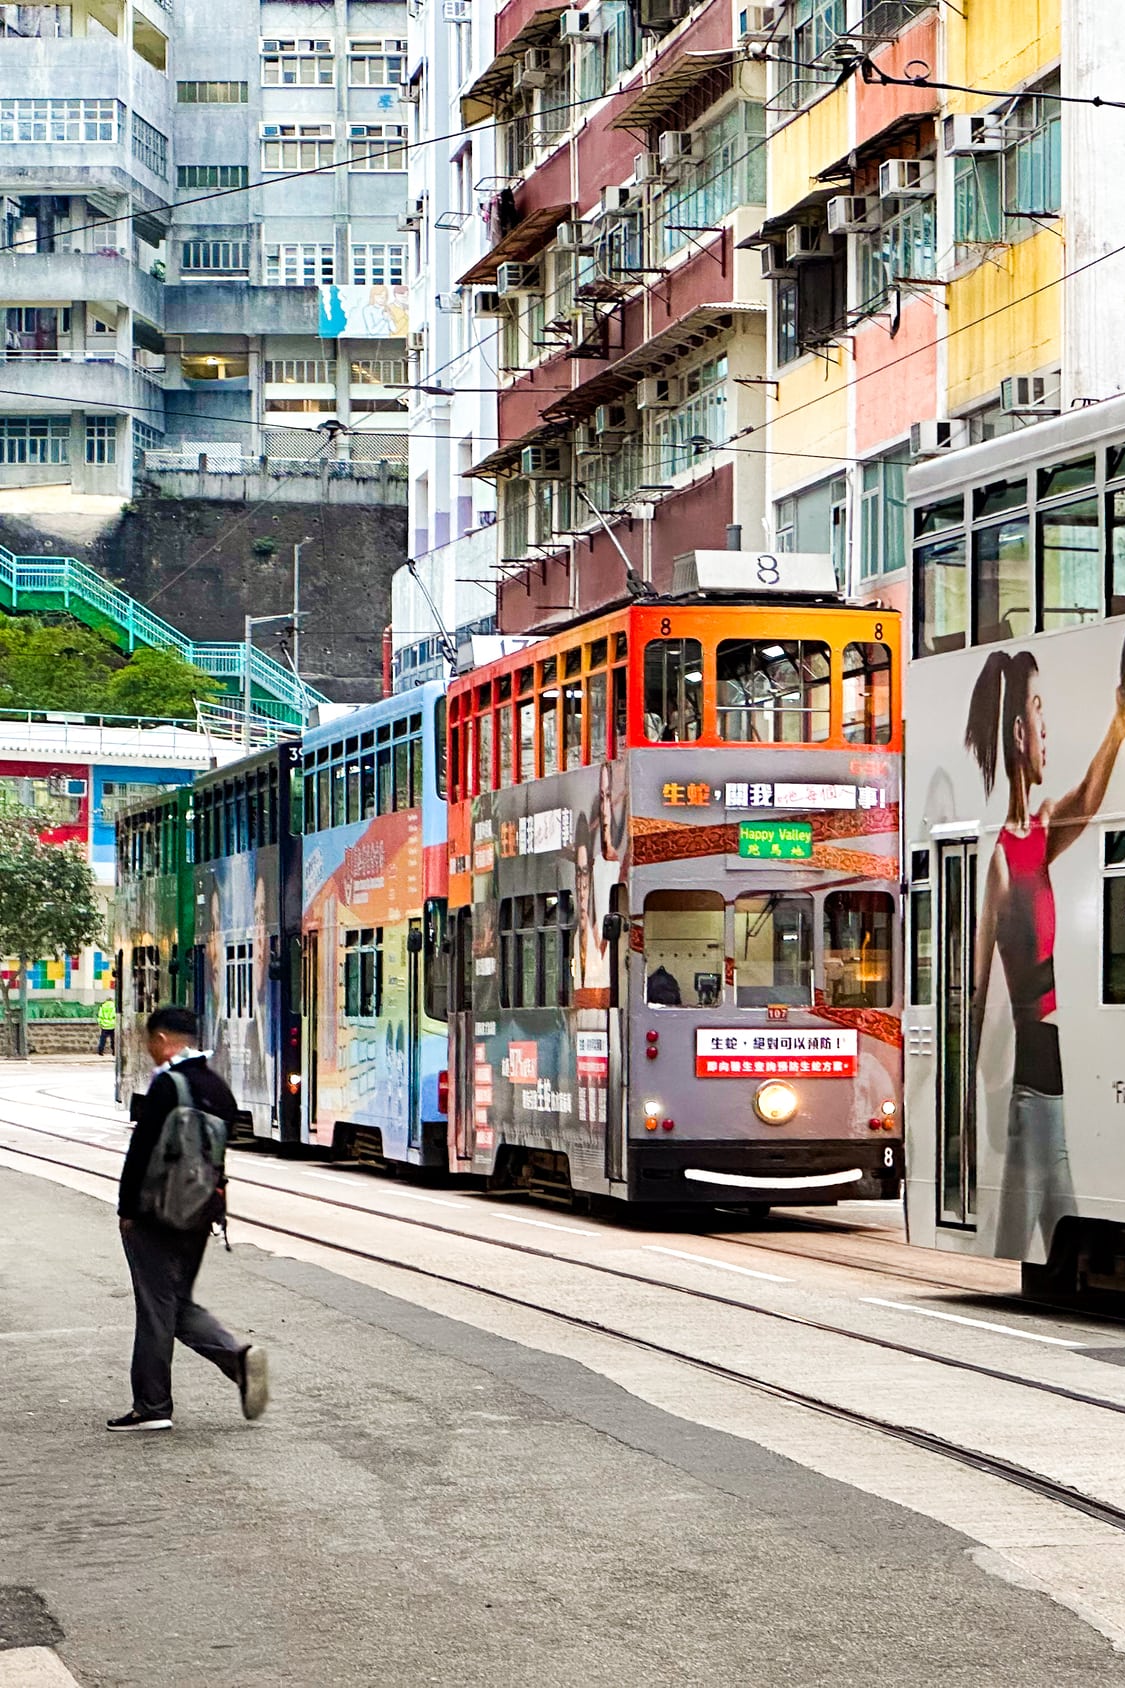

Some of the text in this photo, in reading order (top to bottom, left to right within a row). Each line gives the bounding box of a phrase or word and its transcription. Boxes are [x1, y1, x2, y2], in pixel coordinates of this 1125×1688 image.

[756, 554, 780, 585] 8
[660, 617, 671, 636] 8
[873, 622, 883, 641] 8
[740, 828, 812, 843] Happy Valley
[768, 1008, 787, 1019] 107
[884, 1146, 894, 1168] 8
